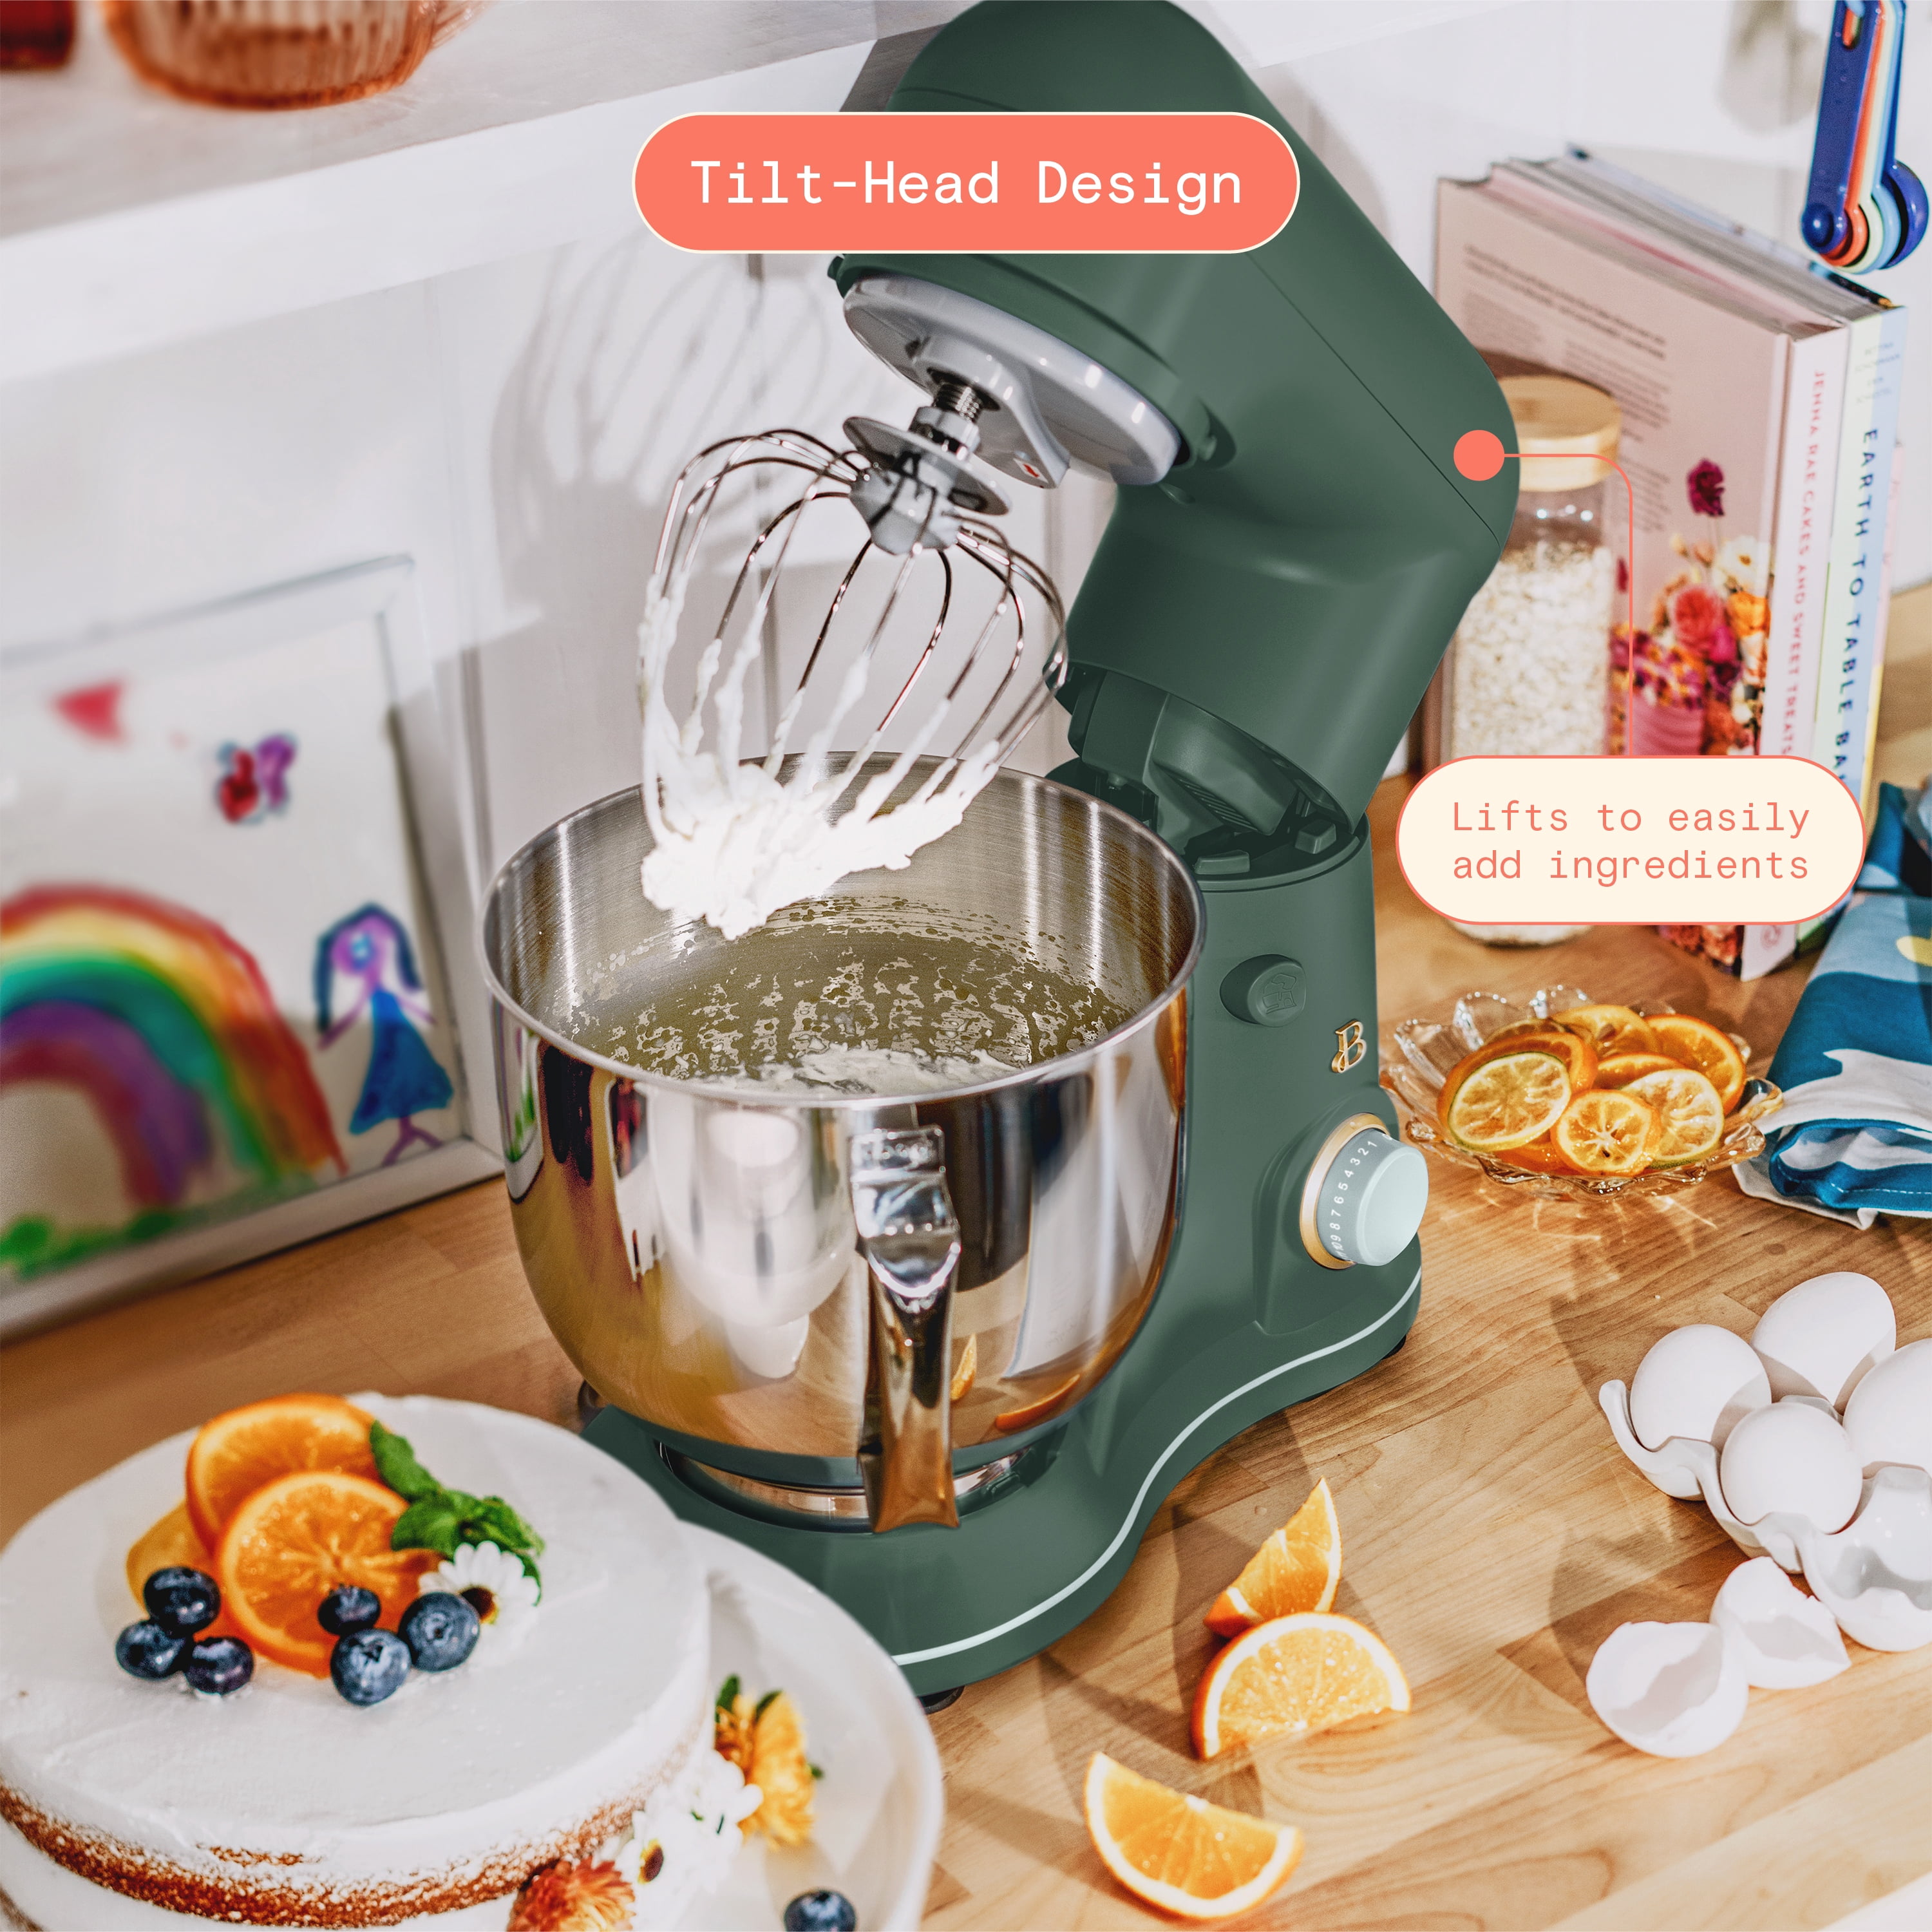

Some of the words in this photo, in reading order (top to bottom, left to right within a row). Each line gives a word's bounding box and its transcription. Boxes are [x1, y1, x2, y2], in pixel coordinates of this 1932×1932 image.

[1810, 370, 1825, 437] JENNA
[1805, 444, 1818, 481] RAE
[1855, 428, 1878, 536] EARTH
[1799, 490, 1814, 556] CAKES
[1794, 564, 1806, 604] AND
[1850, 554, 1866, 596] TO
[1788, 612, 1803, 675] SWEET
[1838, 613, 1861, 713] TABLE
[1782, 684, 1797, 755] TREATS
[1331, 1019, 1367, 1074] B
[1344, 1170, 1354, 1178] 4
[1350, 1157, 1361, 1166] 3
[1334, 1196, 1344, 1204] 6
[1338, 1182, 1349, 1191] 5
[1331, 1242, 1344, 1251] 10
